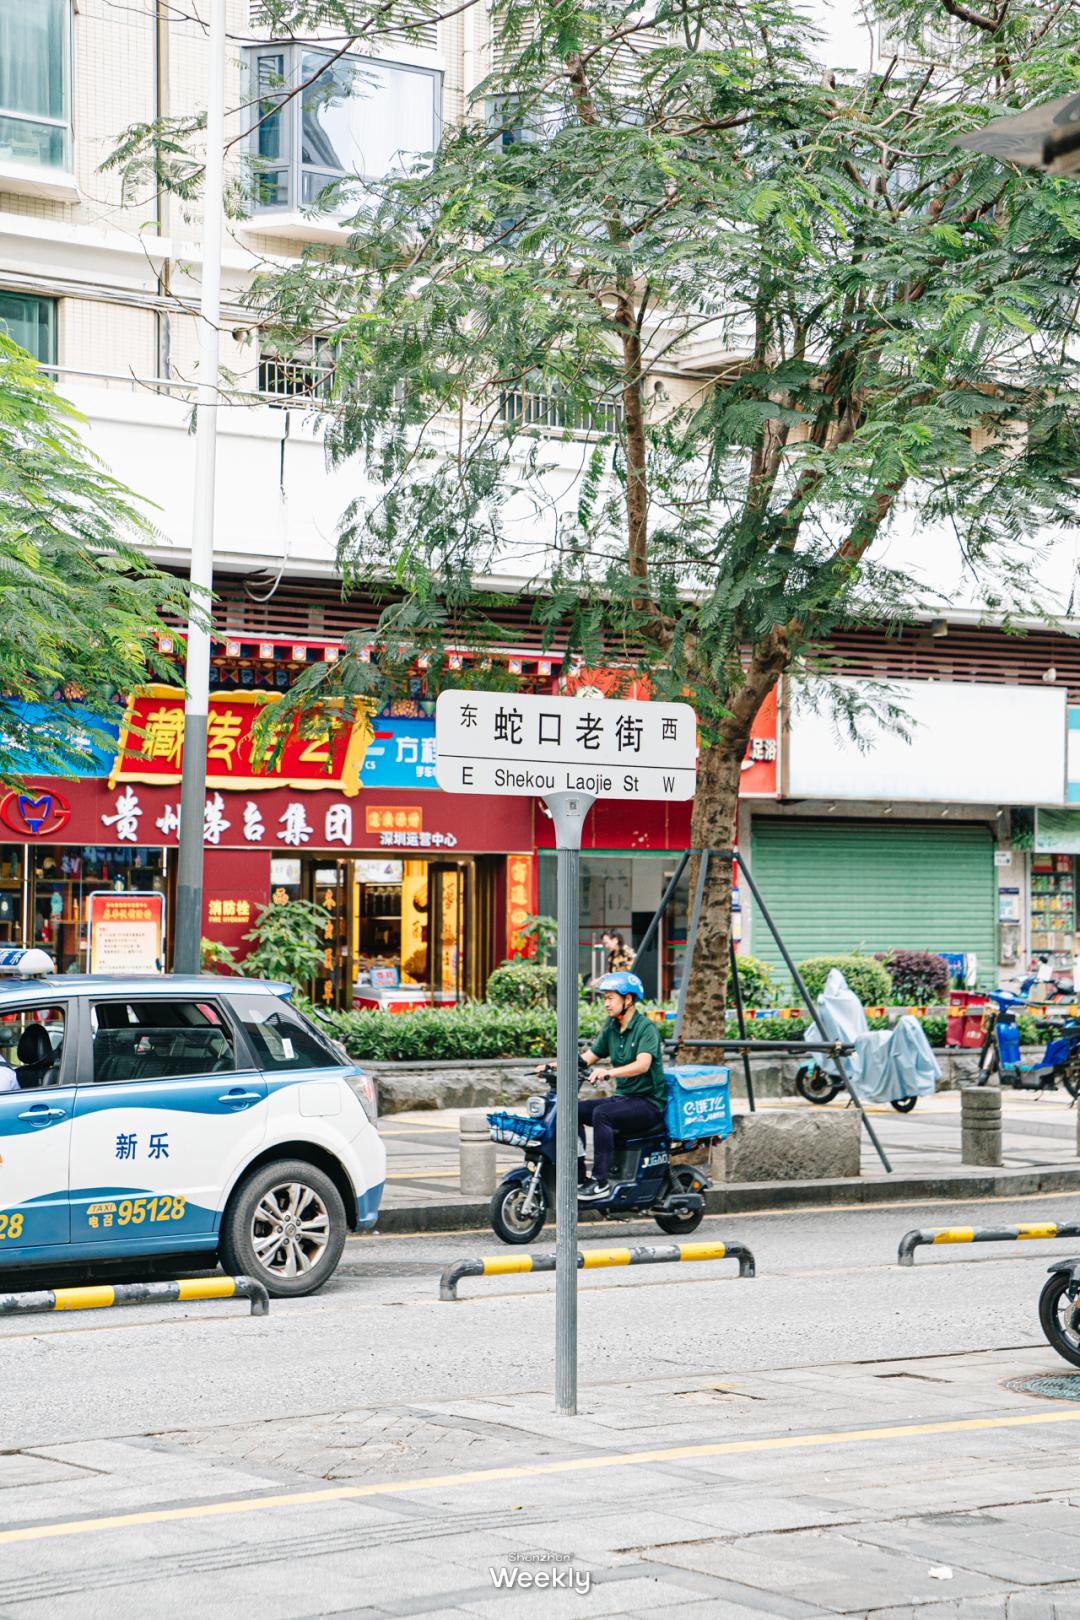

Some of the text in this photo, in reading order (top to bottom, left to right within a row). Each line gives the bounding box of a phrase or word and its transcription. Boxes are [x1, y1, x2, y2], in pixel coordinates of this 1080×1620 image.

[460, 704, 679, 753] 东 蛇口老街 西
[462, 766, 675, 794] E Shekou Laojie St W
[101, 785, 353, 848] 贵州茅台集团
[380, 831, 458, 848] 深圳运营中心
[208, 899, 250, 916] 消防栓
[115, 1132, 170, 1160] 新乐
[88, 1213, 113, 1229] 电召
[117, 1195, 187, 1226] 95128
